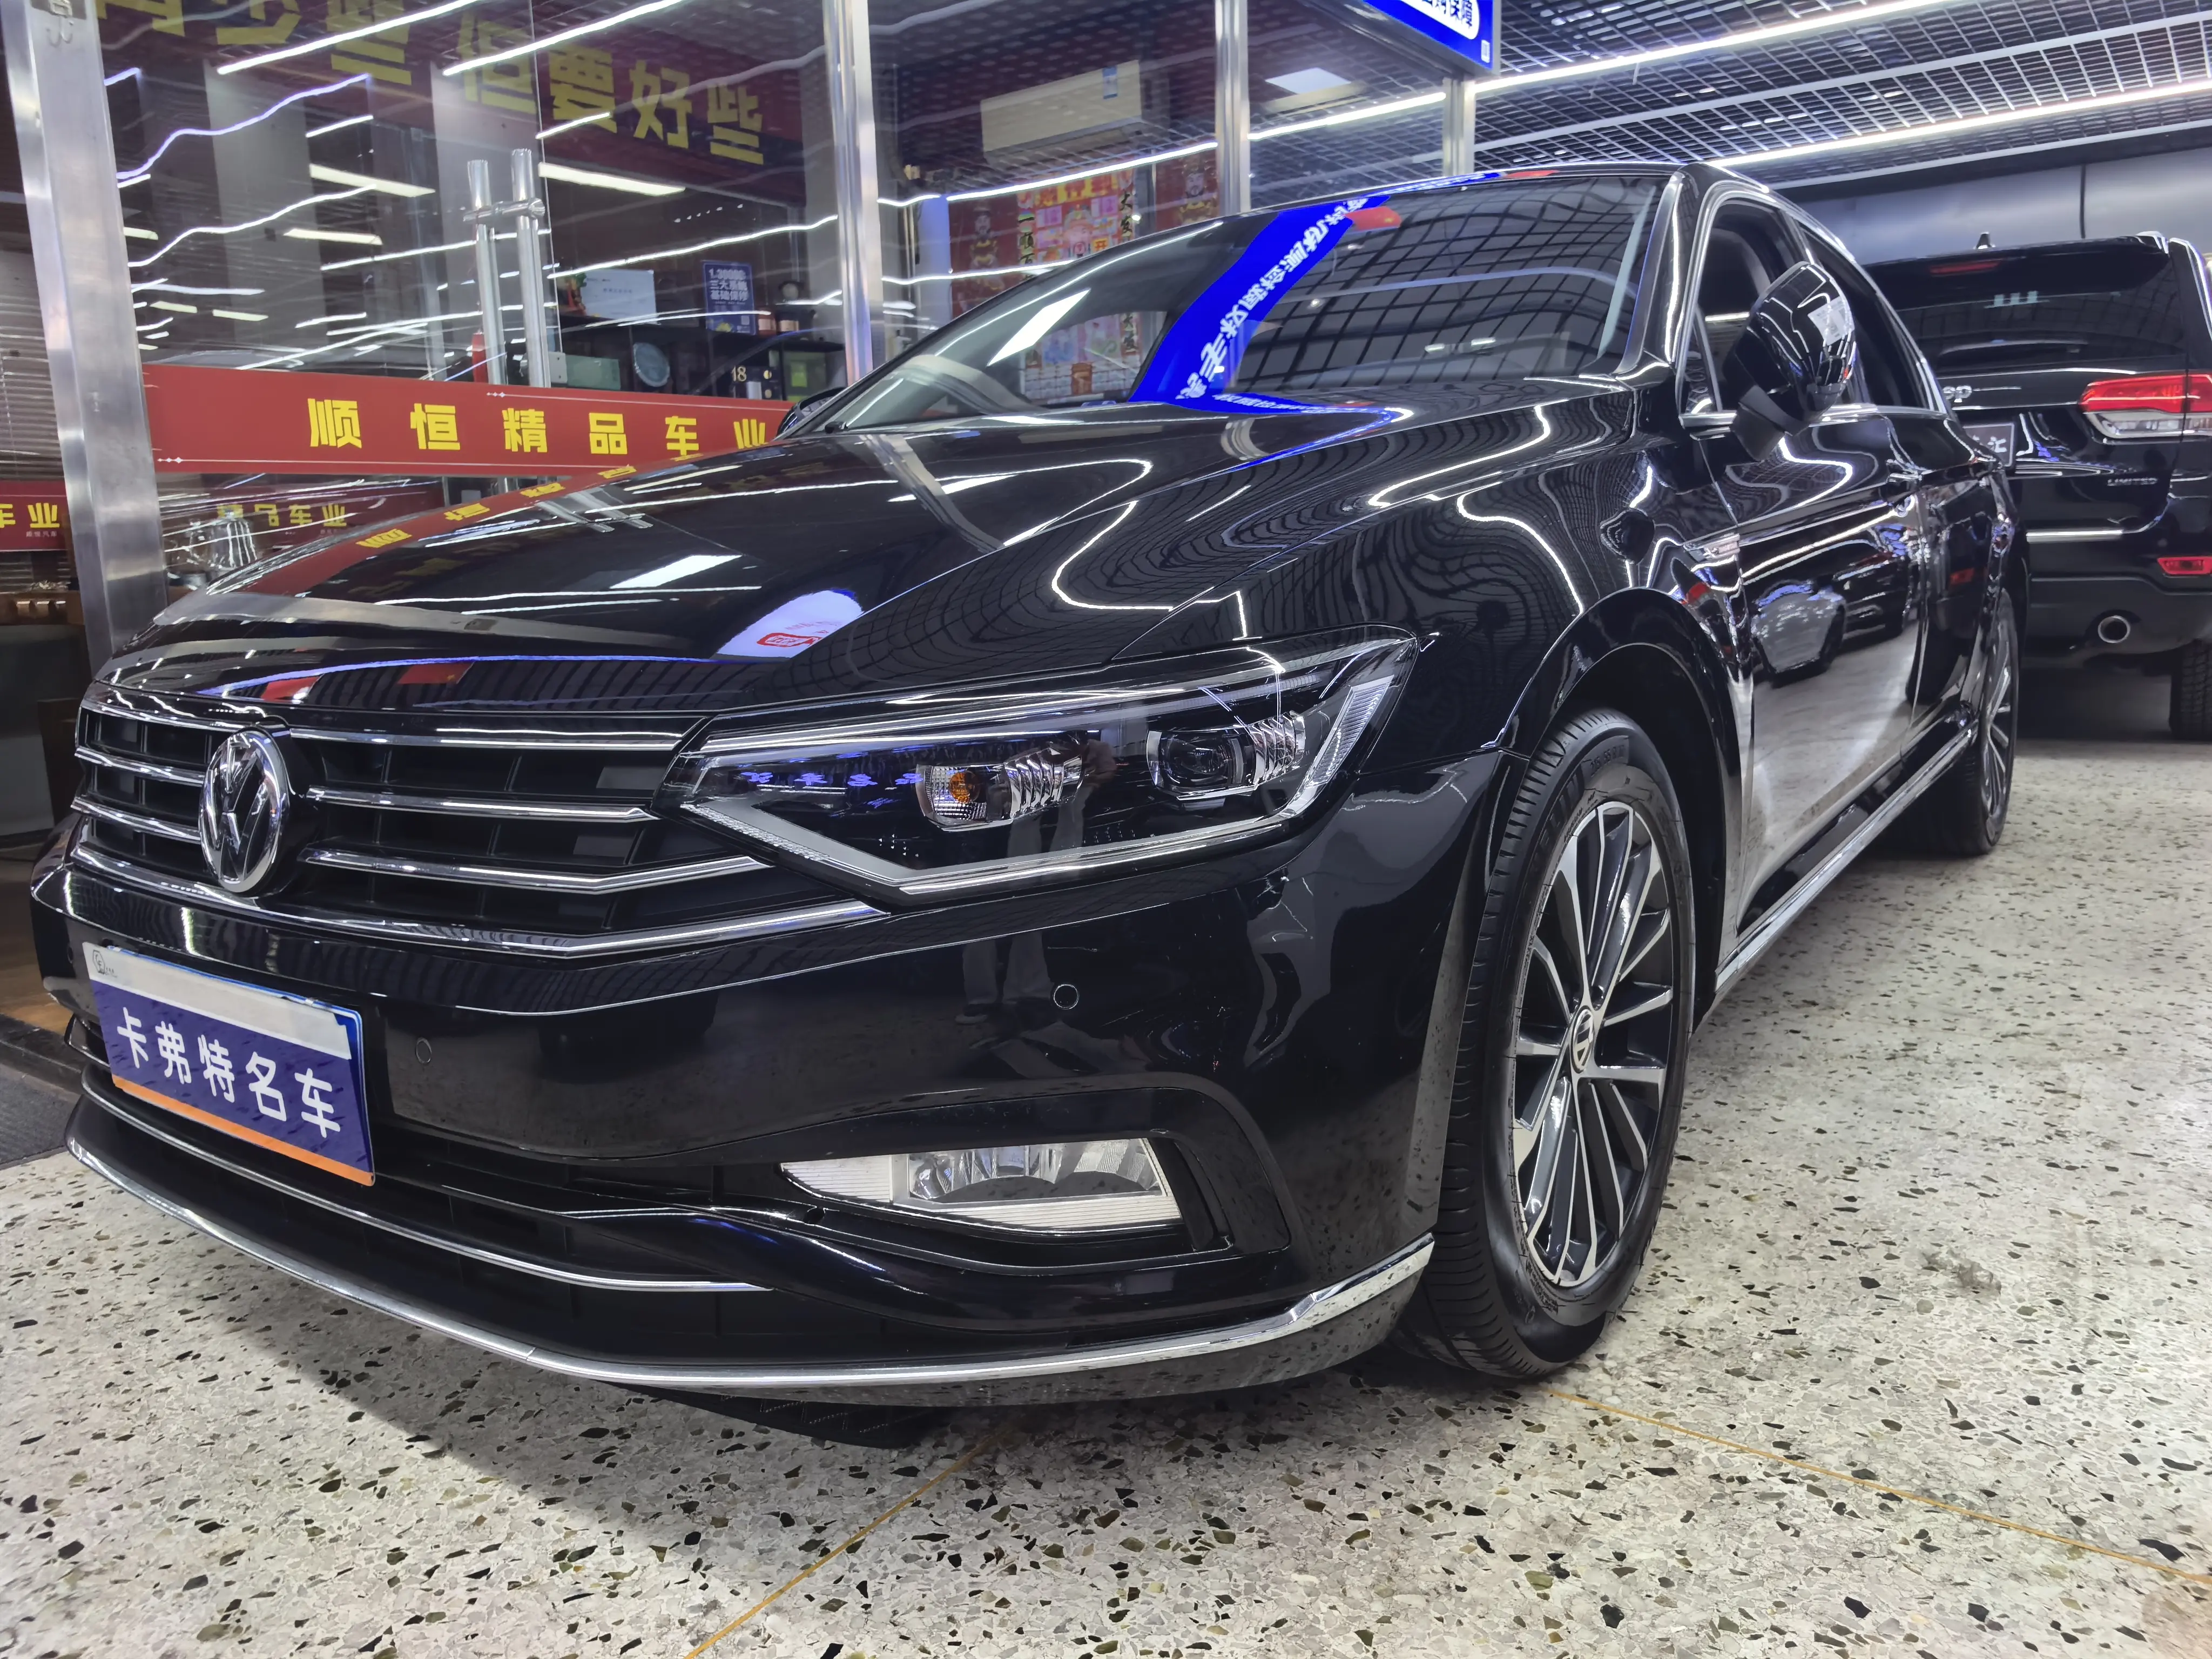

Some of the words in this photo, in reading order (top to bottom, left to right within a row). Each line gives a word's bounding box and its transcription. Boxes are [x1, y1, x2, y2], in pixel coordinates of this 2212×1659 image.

[307, 399, 767, 456] 顺恒精品车业
[117, 1007, 341, 1138] 卡弗特名车
